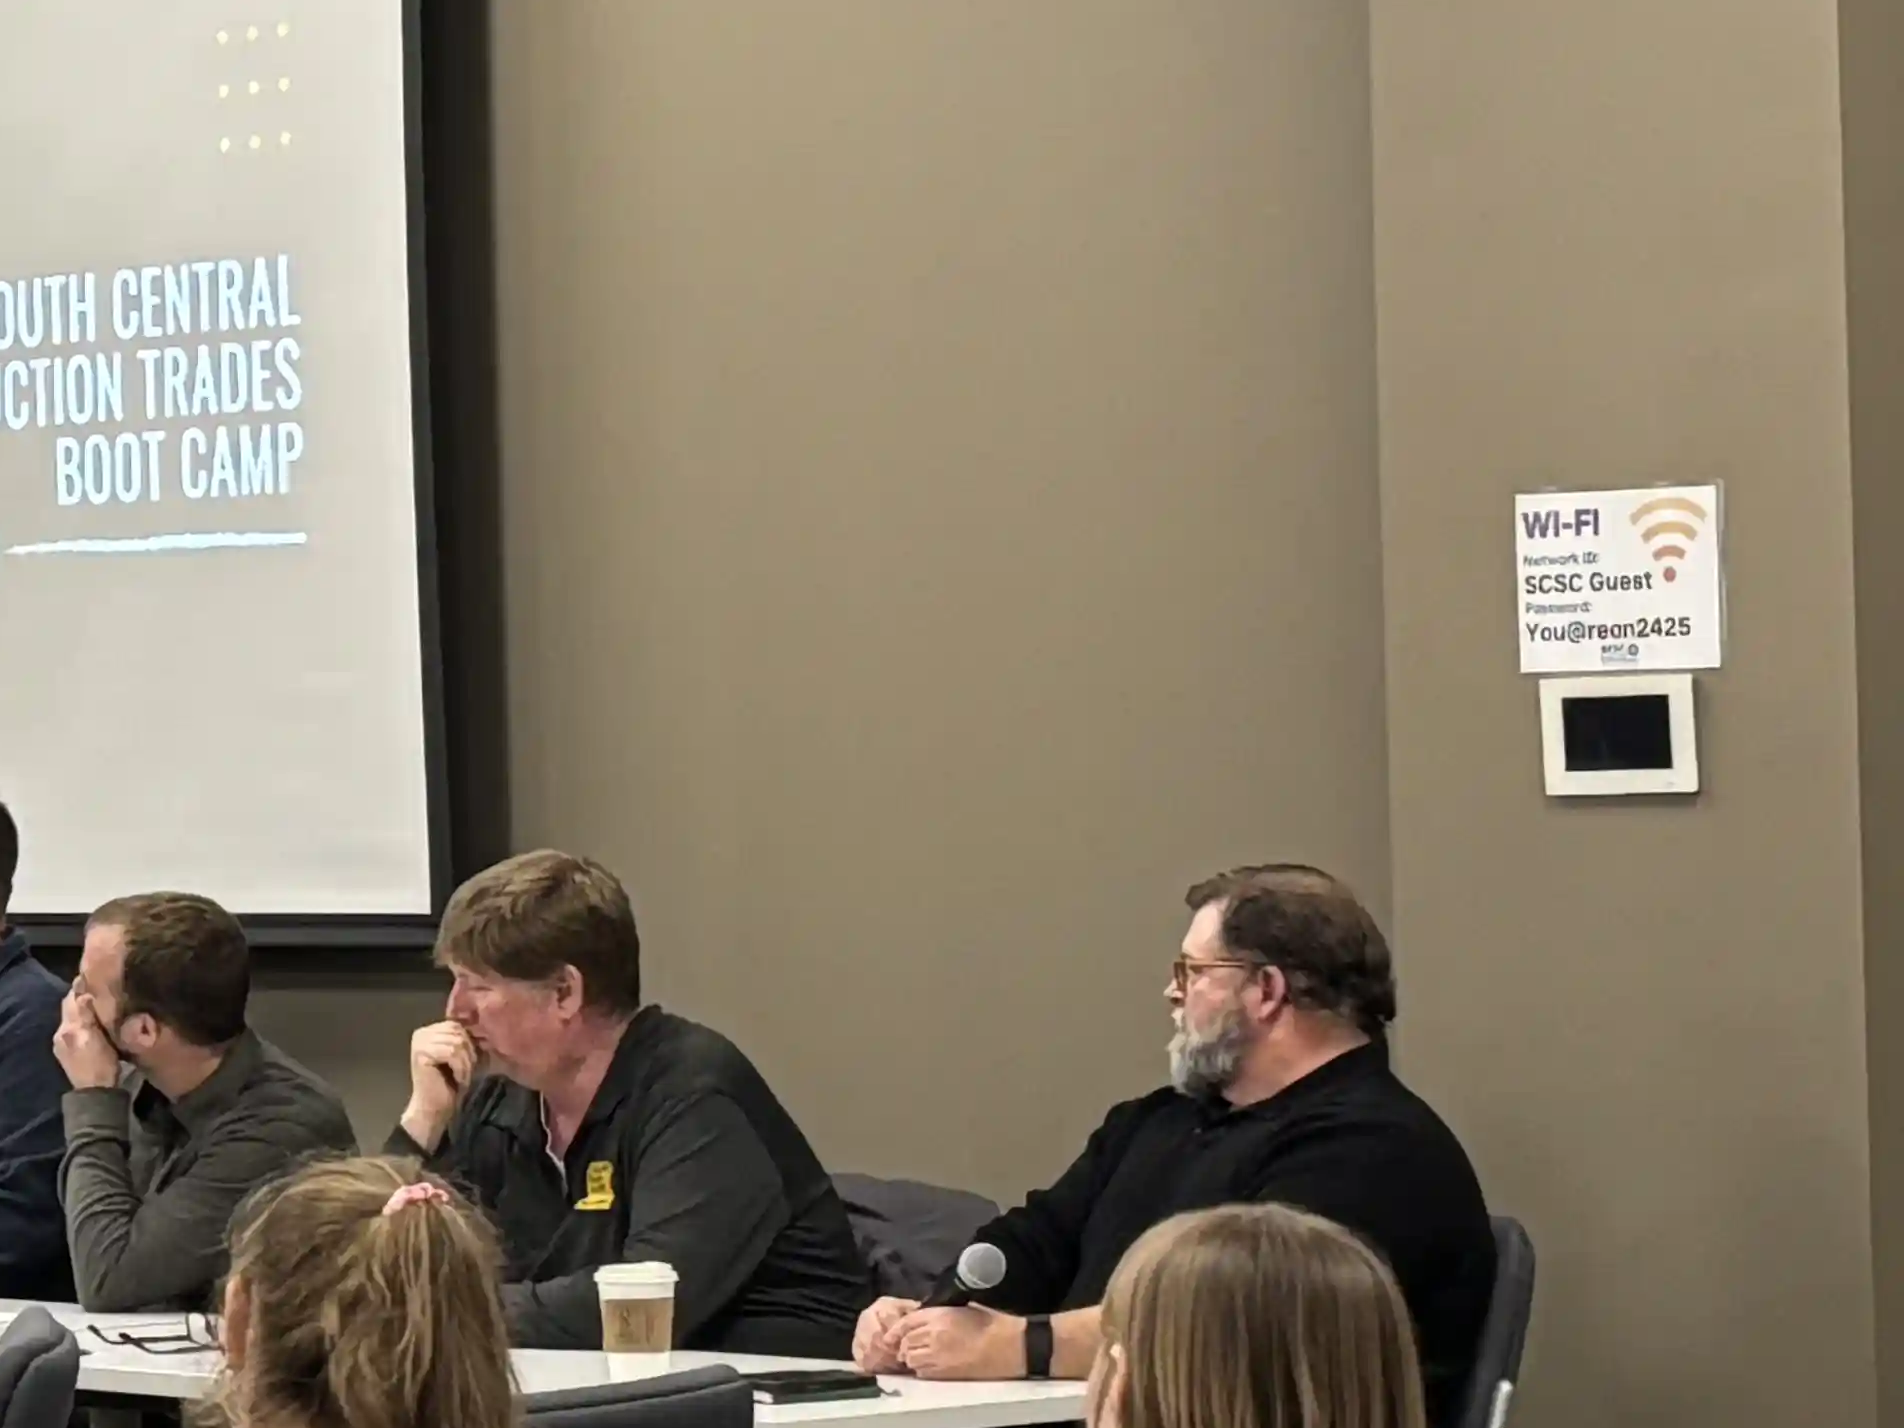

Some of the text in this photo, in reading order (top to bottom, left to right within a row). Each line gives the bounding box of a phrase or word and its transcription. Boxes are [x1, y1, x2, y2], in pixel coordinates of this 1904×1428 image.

[112, 253, 302, 340] CENTRAL
[136, 337, 303, 420] TRADES
[56, 421, 304, 506] BOOT CAMP
[1525, 571, 1652, 594] SCSC Guest
